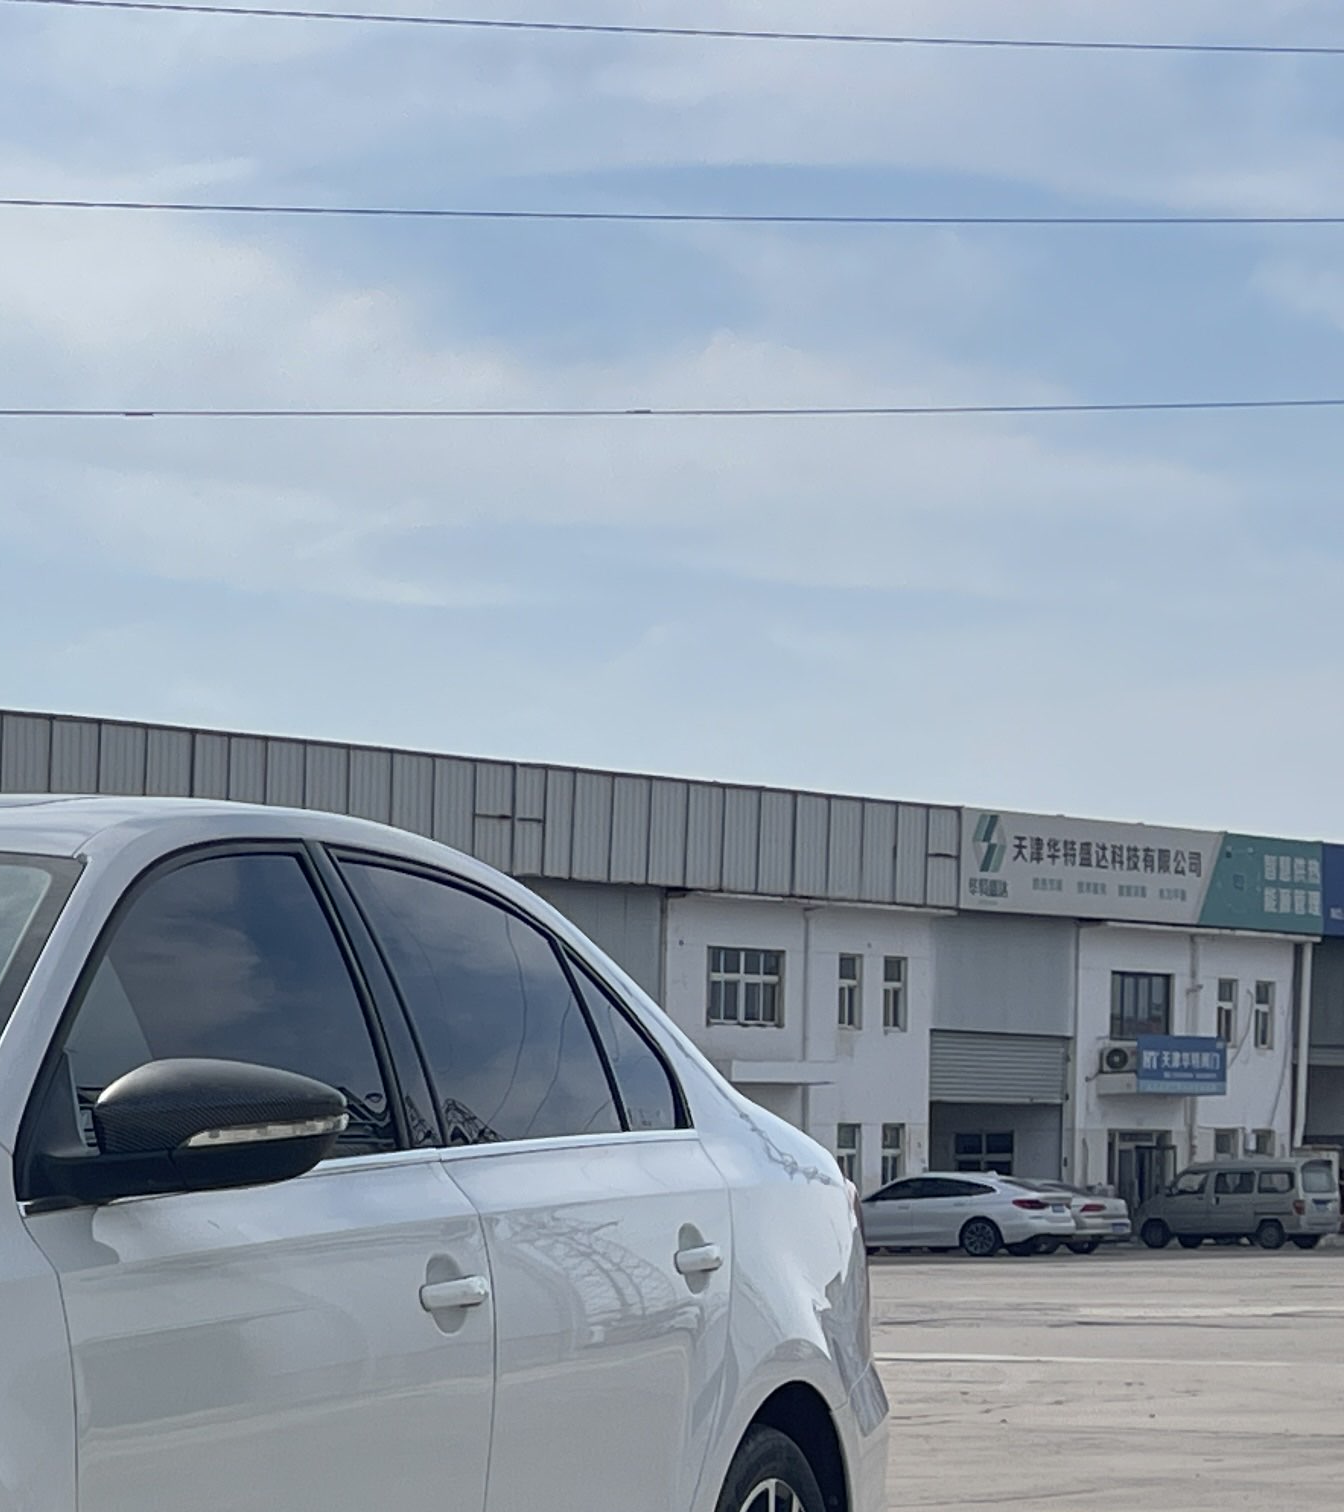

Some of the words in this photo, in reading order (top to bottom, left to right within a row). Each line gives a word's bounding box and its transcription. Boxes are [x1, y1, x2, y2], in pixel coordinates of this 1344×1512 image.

[1012, 835, 1202, 878] 天津华特盛达科技有限公司
